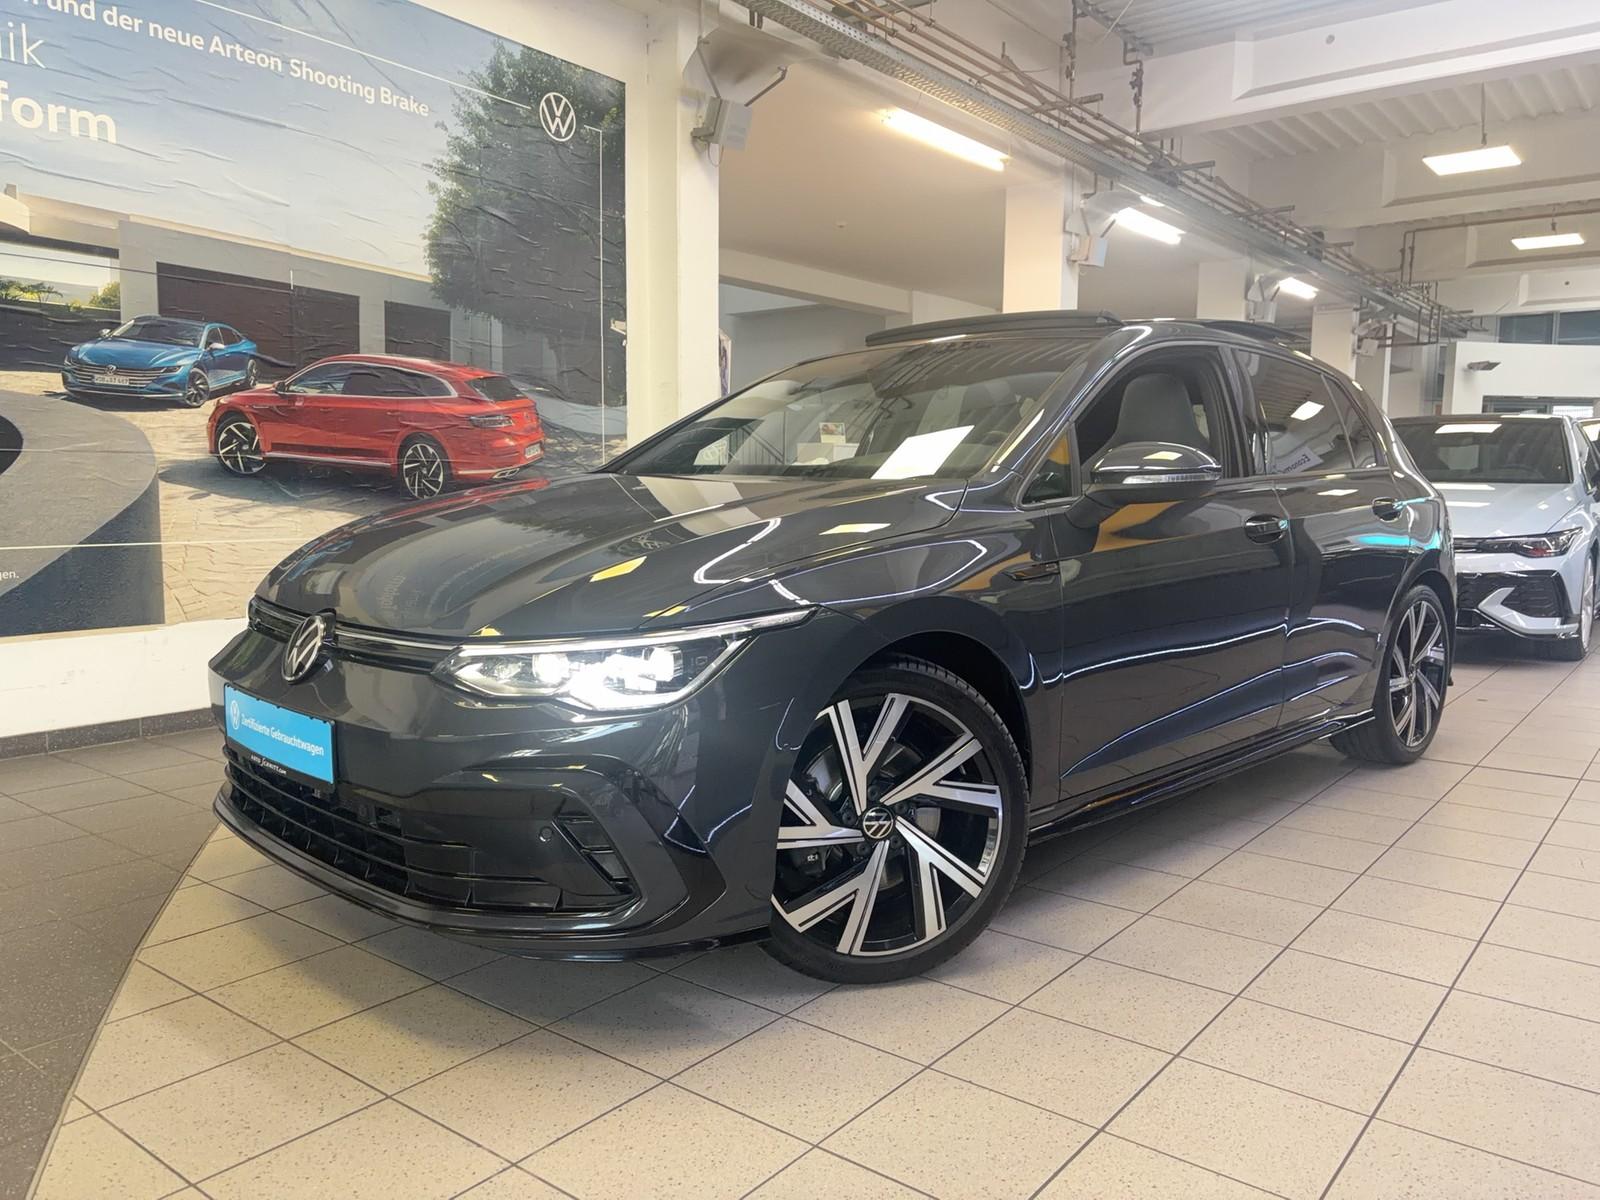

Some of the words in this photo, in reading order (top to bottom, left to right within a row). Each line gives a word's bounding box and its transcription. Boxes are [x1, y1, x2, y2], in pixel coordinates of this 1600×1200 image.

[0, 21, 47, 69] ik
[47, 0, 96, 21] und
[102, 6, 144, 33] der
[149, 22, 205, 51] neue
[208, 35, 283, 73] Arteon
[289, 58, 376, 104] Shooting
[380, 86, 430, 117] Brake
[539, 92, 577, 142] VW
[0, 570, 20, 580] en.
[270, 726, 325, 757] Gebrauchtwagen
